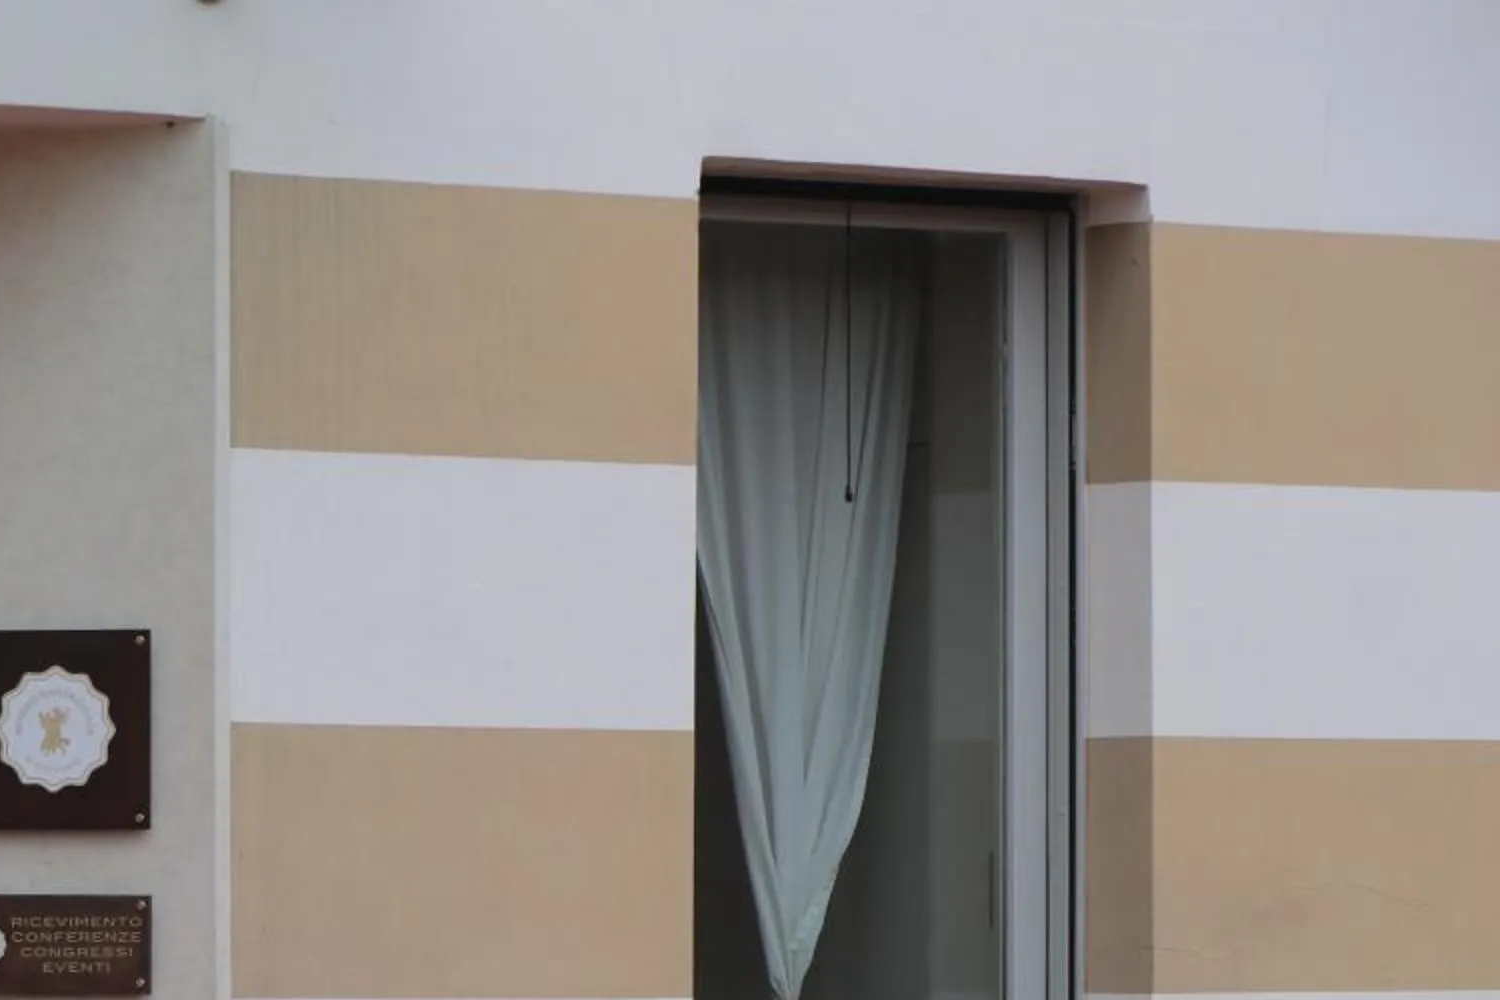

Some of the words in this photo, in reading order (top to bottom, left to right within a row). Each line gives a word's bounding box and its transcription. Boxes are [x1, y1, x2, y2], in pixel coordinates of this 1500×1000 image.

[11, 916, 143, 929] RICEVIMENTO
[11, 931, 141, 944] CONFERENZE
[20, 947, 133, 958] CONGRESSI
[42, 962, 111, 974] EVENTI
